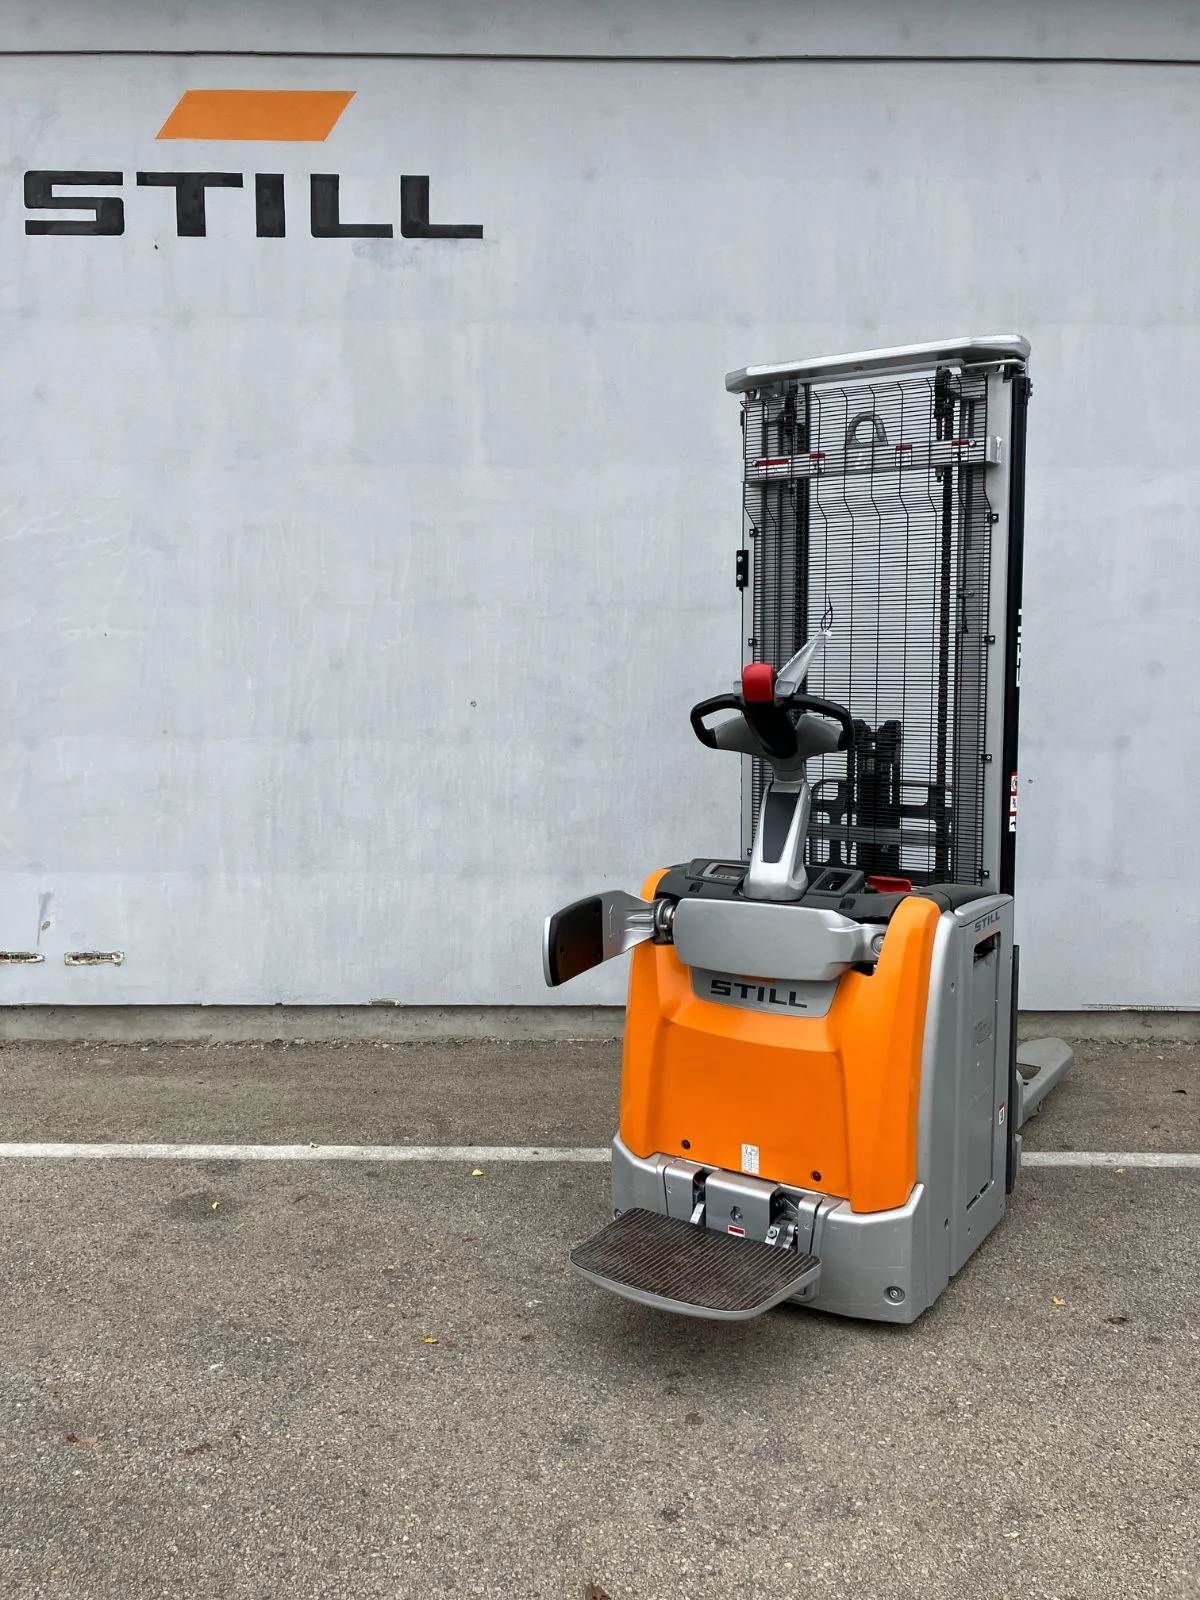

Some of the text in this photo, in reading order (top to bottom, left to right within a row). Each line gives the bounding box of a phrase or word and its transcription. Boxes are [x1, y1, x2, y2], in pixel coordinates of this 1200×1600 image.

[24, 170, 484, 238] STILL
[974, 911, 1001, 933] STILL
[710, 979, 808, 1009] STILL
